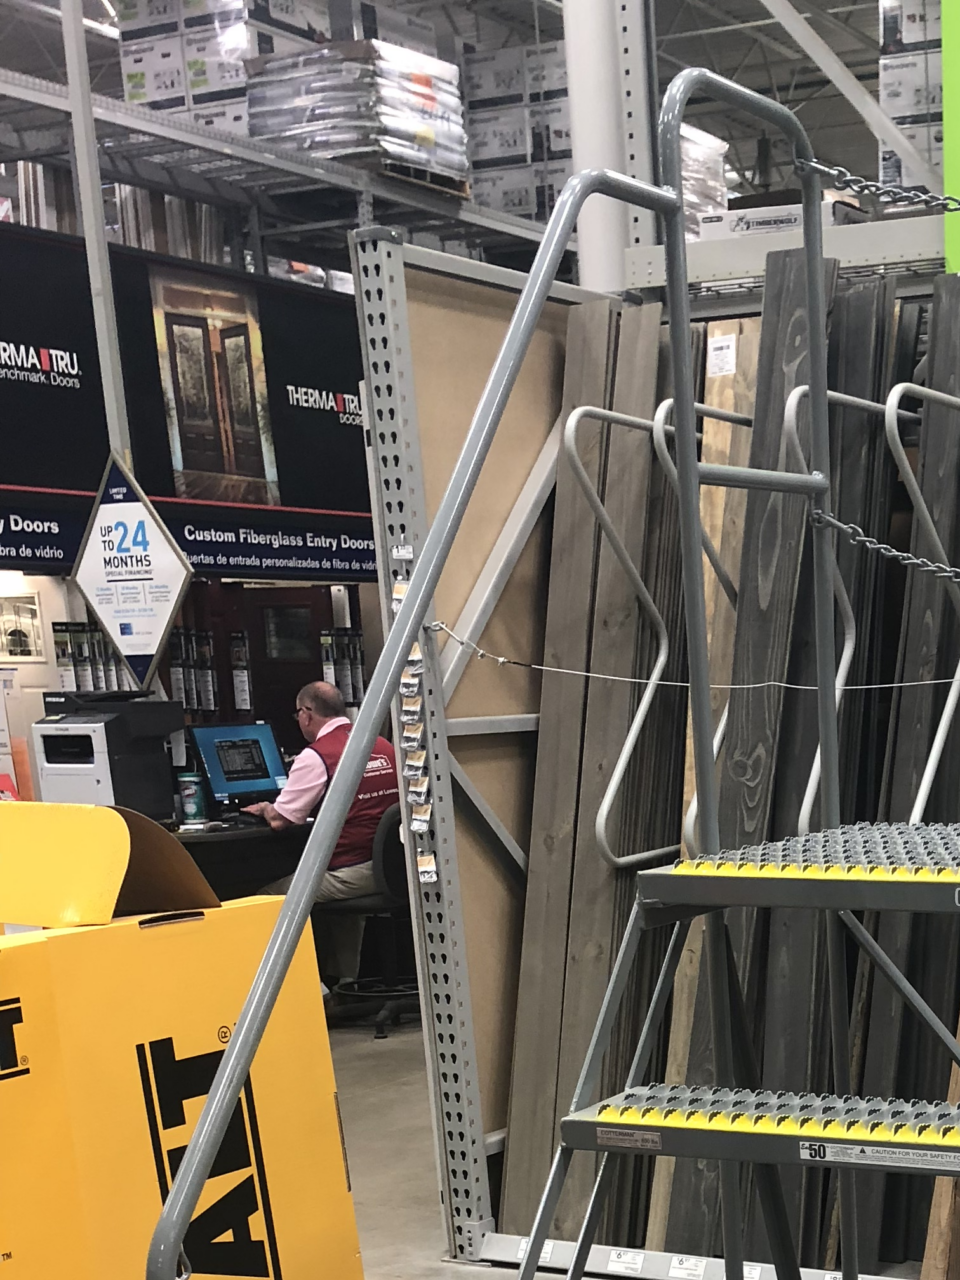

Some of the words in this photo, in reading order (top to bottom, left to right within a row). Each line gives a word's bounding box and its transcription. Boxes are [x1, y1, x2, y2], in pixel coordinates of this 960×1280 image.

[752, 217, 798, 228] TIMBERWOLF
[0, 341, 41, 369] RMA
[49, 349, 78, 375] TRU
[50, 373, 80, 388] Doors
[9, 514, 60, 534] Doors
[100, 526, 113, 537] UP
[114, 520, 150, 553] 24
[184, 525, 235, 543] Custom
[239, 528, 303, 549] Fiberglass
[306, 533, 338, 551] Entry
[341, 535, 375, 550] Doors
[19, 544, 32, 558] de
[34, 545, 64, 559] vidrio
[102, 540, 114, 551] TO
[103, 555, 151, 569] MONTHS
[216, 553, 228, 565] de
[229, 555, 260, 567] entrada
[262, 557, 320, 569] personalizadas
[321, 558, 331, 569] de
[332, 560, 350, 570] fibra
[351, 560, 361, 570] de
[362, 561, 377, 571] vidri
[601, 1130, 634, 1138] COTTERMAN
[809, 1144, 826, 1159] 50
